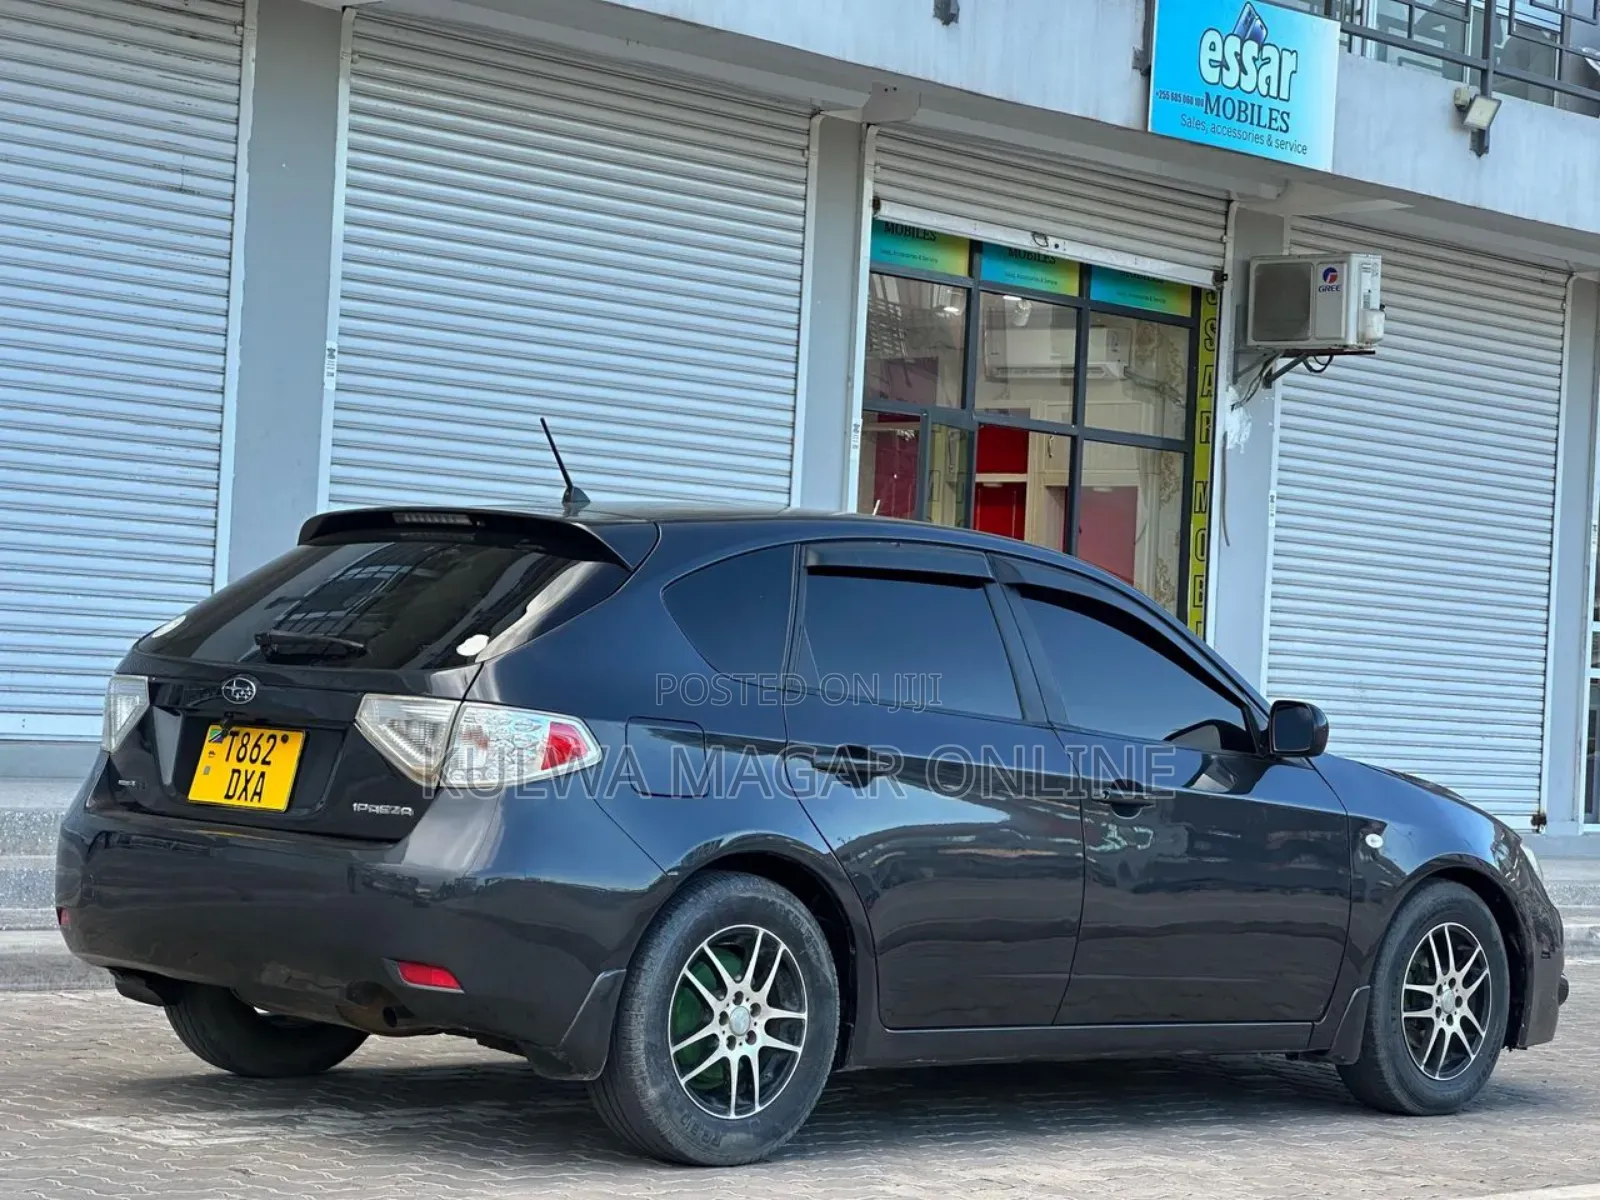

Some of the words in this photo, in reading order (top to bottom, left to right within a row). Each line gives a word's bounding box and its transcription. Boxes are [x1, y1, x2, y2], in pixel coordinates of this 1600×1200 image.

[1199, 28, 1298, 103] essar
[1203, 91, 1291, 134] MOBILES
[1180, 113, 1208, 134] Sales,
[1209, 123, 1265, 147] accessories
[1266, 134, 1274, 147] &
[1274, 137, 1308, 155] service
[884, 221, 937, 242] MOBILES
[1008, 247, 1056, 265] MOBILES
[1318, 284, 1341, 293] GREE
[225, 730, 277, 766] T862
[224, 768, 266, 803] DXA
